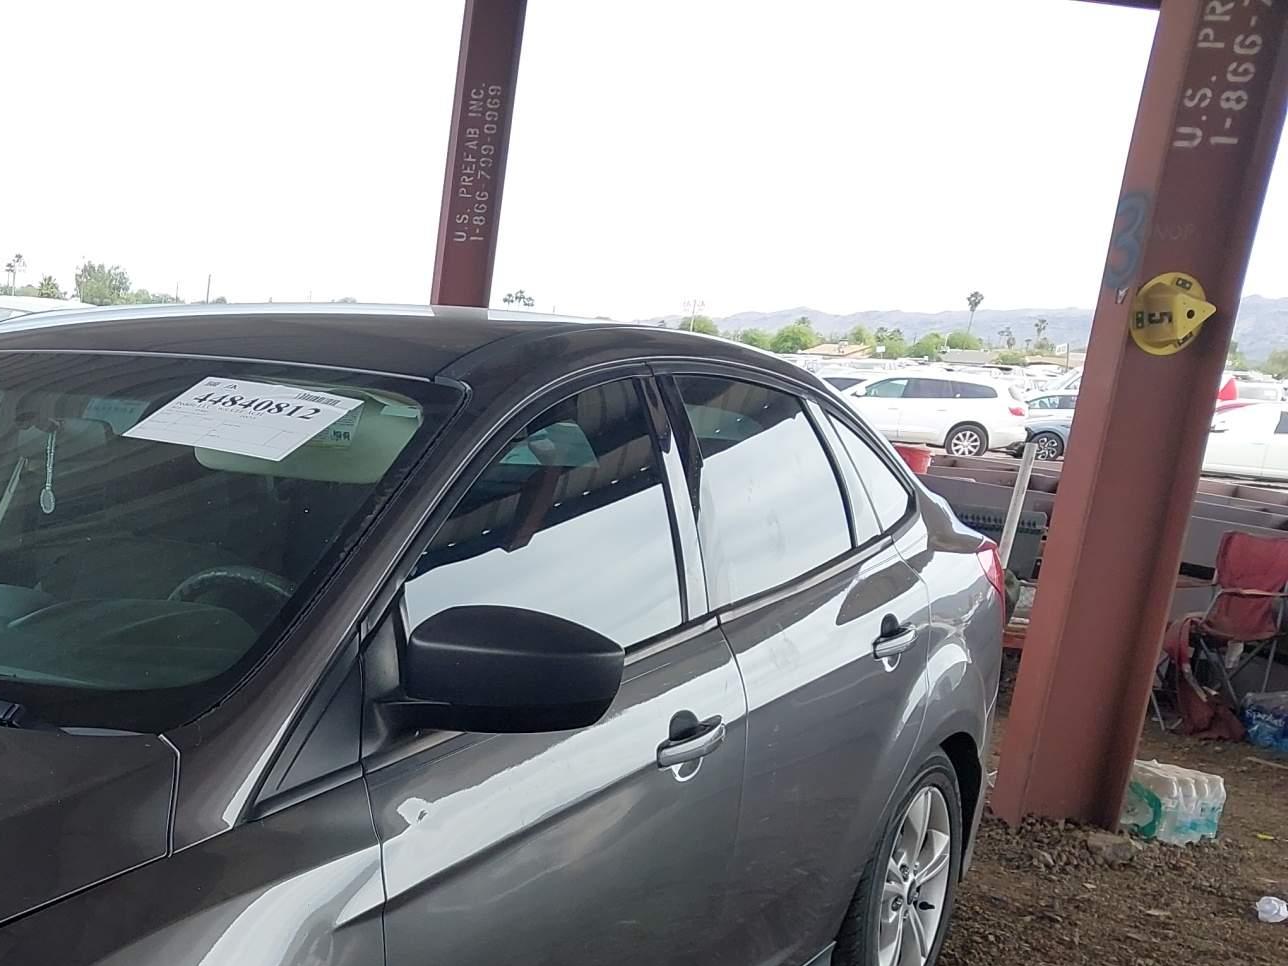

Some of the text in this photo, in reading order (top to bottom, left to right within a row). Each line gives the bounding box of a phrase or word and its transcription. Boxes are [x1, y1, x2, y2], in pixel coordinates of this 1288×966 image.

[453, 83, 486, 242] U.S. PREFAB INC.
[470, 84, 502, 242] 1-866-799-0969
[1173, 75, 1217, 148] U.S.
[193, 392, 321, 420] 44840812
